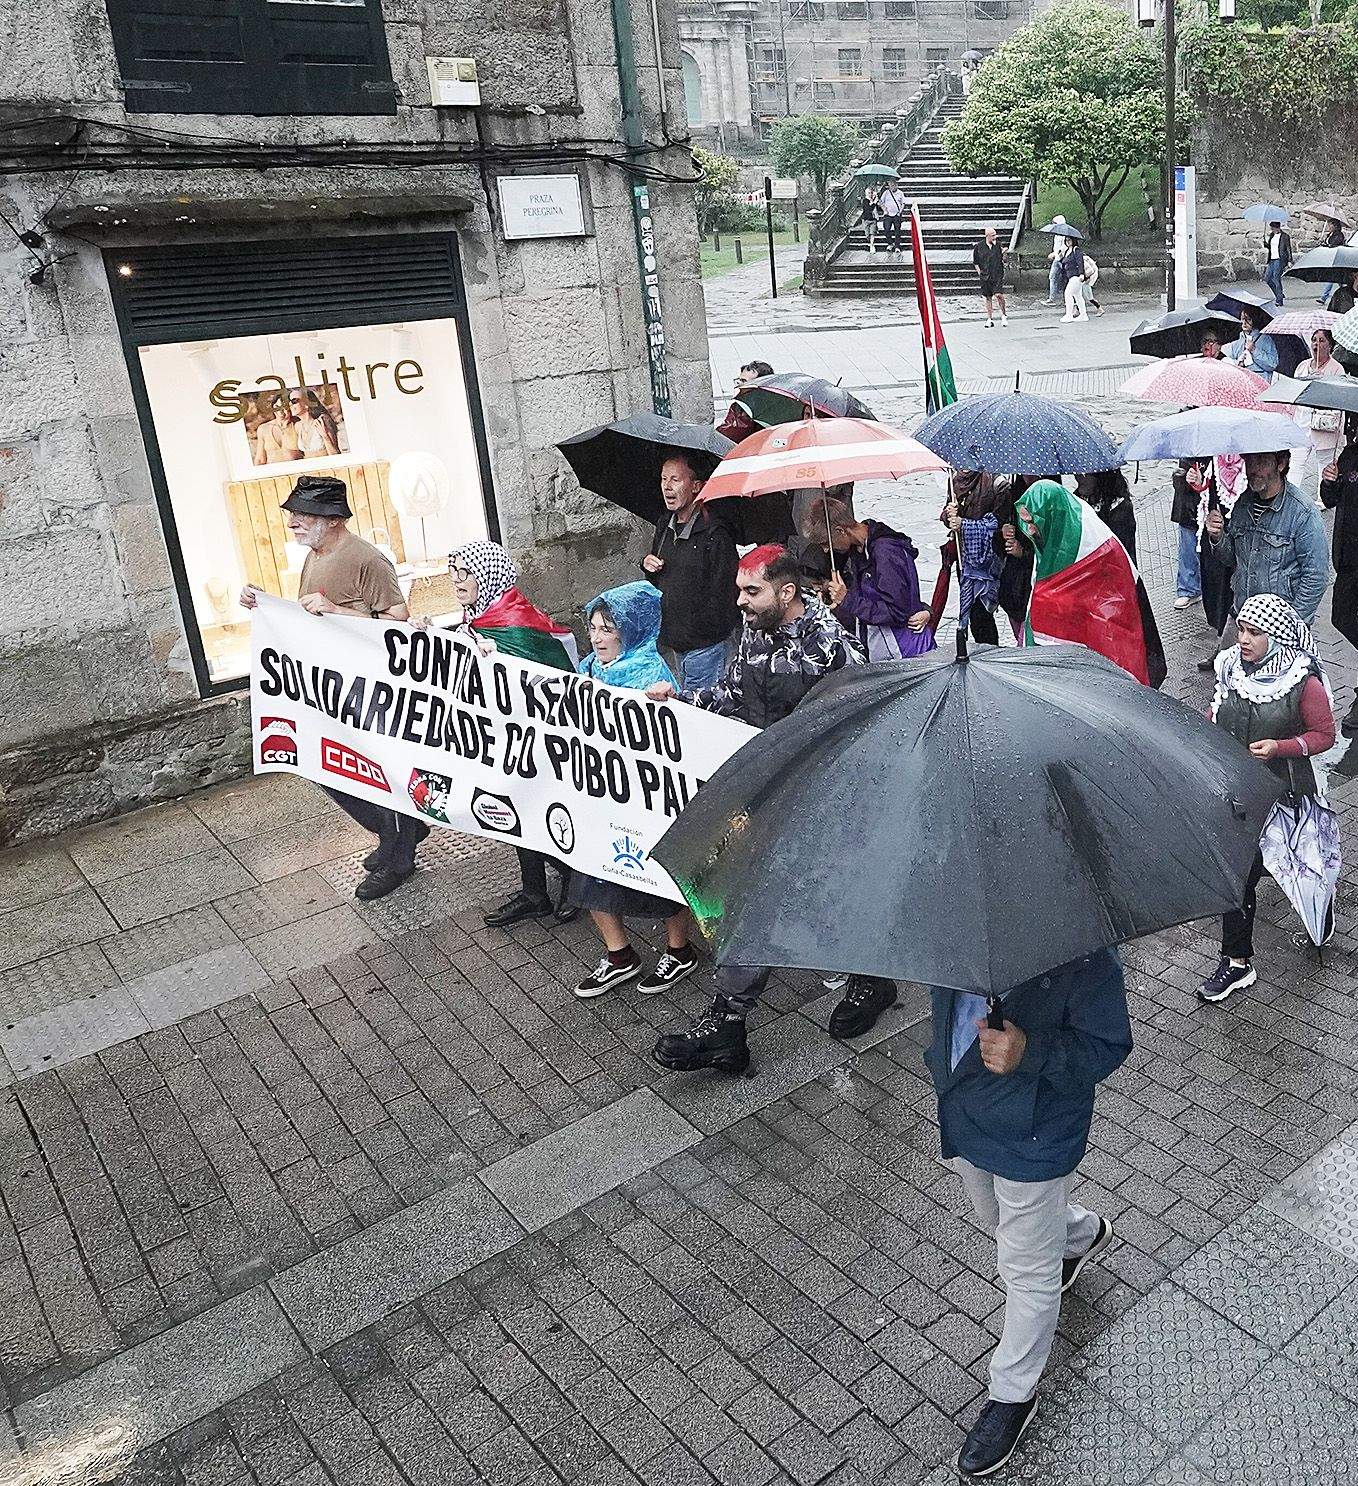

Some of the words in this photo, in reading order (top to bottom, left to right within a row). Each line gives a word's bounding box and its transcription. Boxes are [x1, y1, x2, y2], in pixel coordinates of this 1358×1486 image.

[522, 206, 566, 217] PEREGRINA
[529, 194, 555, 204] PRAZA
[209, 353, 424, 424] salitre
[493, 662, 513, 716] O
[260, 648, 496, 767] SOLIDARIEDADE
[503, 722, 538, 779] CO
[544, 733, 631, 804] POBO
[263, 749, 297, 764] CGT
